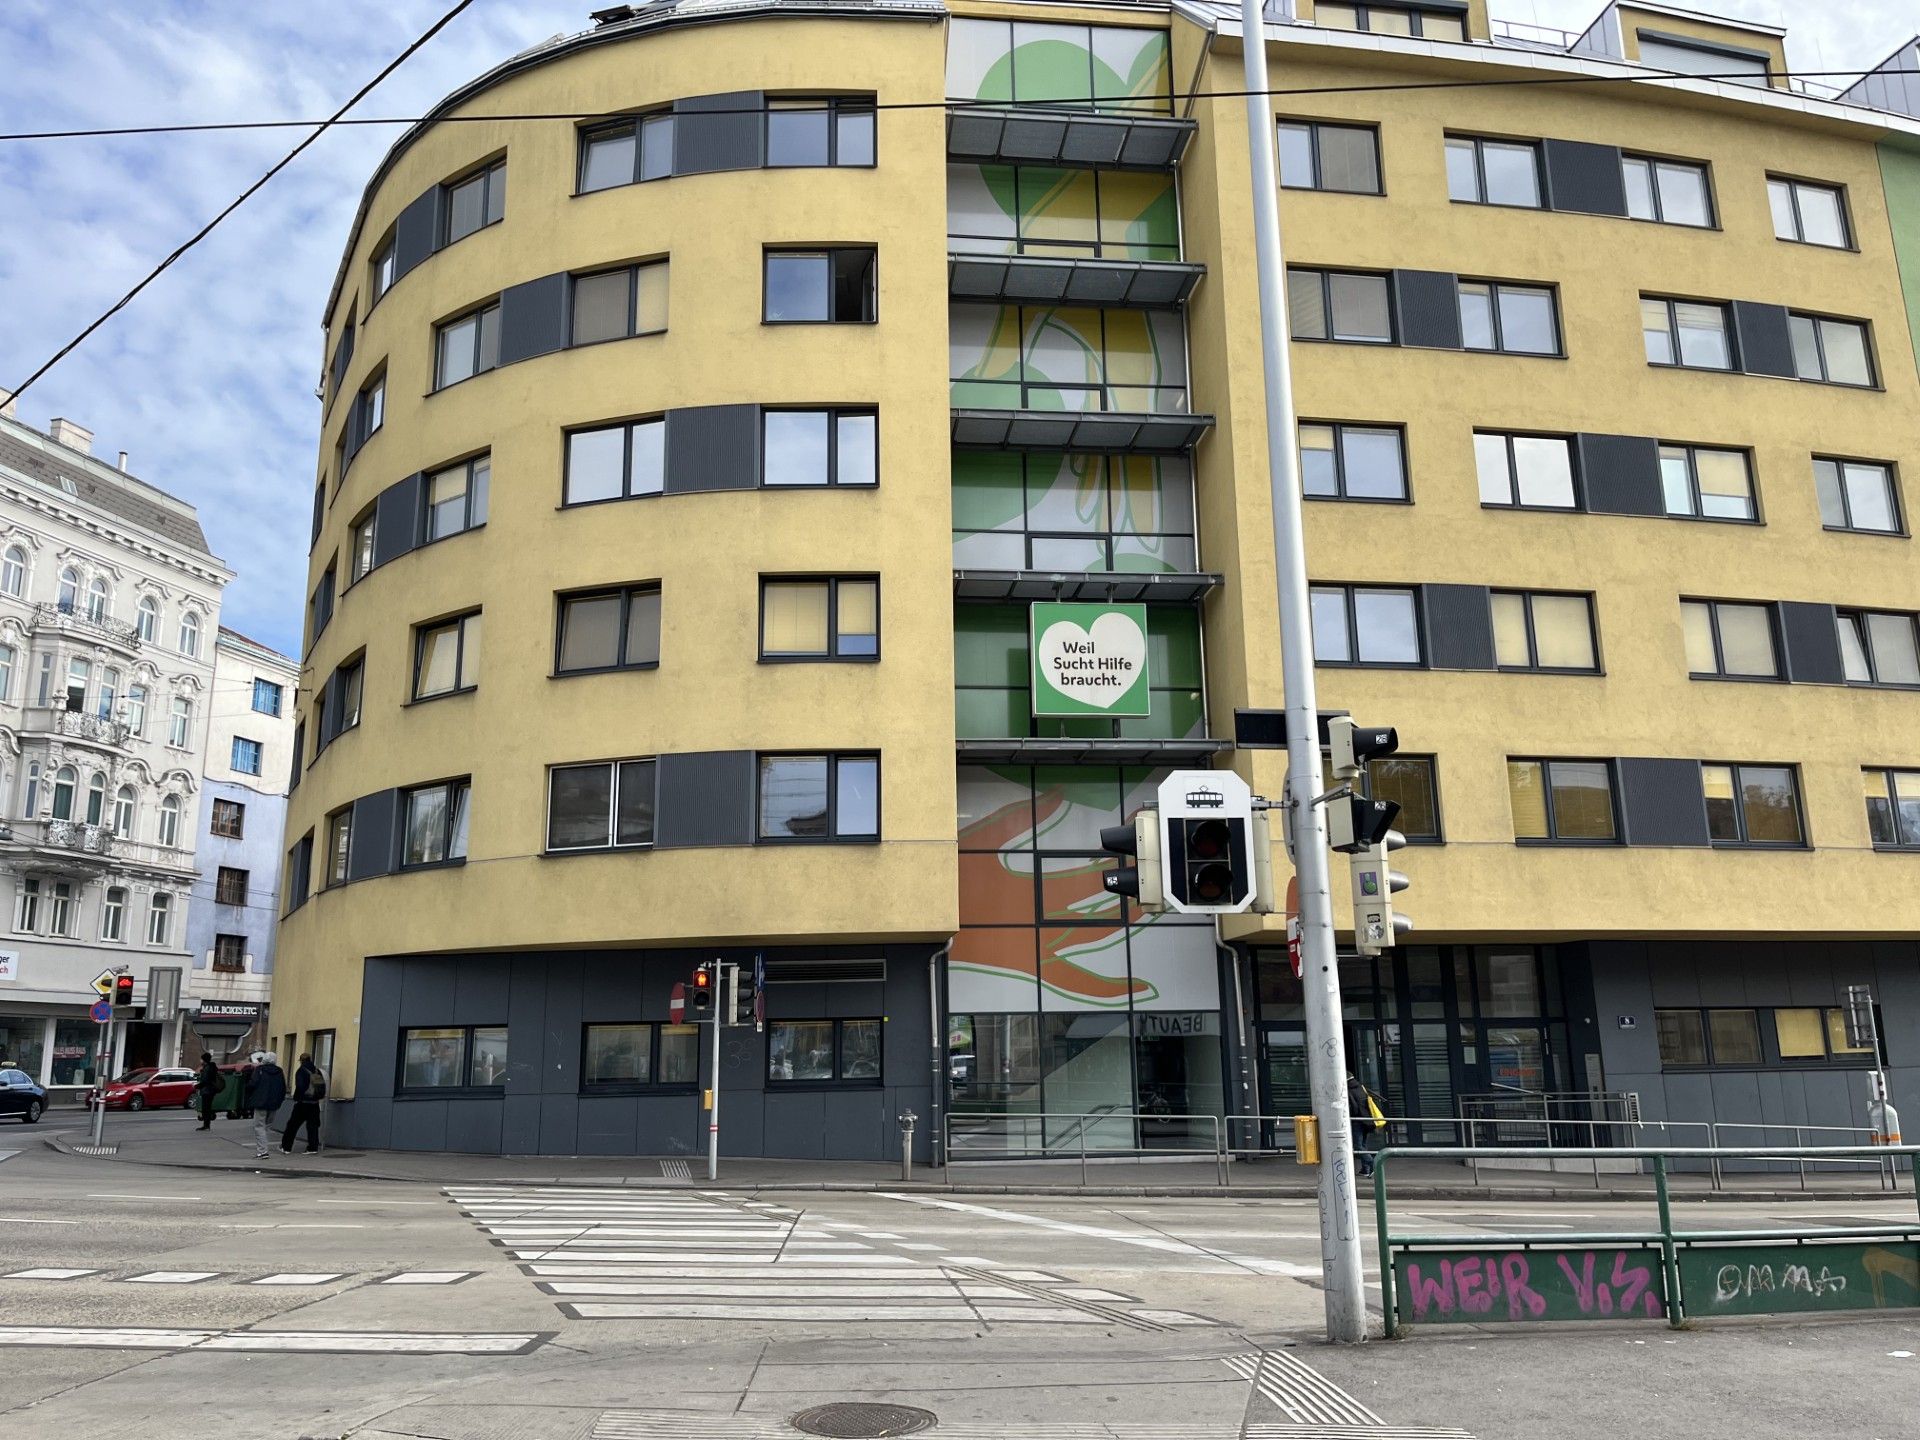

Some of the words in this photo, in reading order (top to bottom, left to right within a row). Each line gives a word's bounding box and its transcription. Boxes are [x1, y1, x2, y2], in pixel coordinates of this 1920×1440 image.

[1062, 641, 1095, 654] Weil
[1053, 657, 1094, 670] Sucht
[1098, 658, 1132, 670] Hilfe
[1061, 673, 1121, 686] braucht.
[201, 1005, 220, 1014] MAIL
[221, 1006, 243, 1015] BOXES
